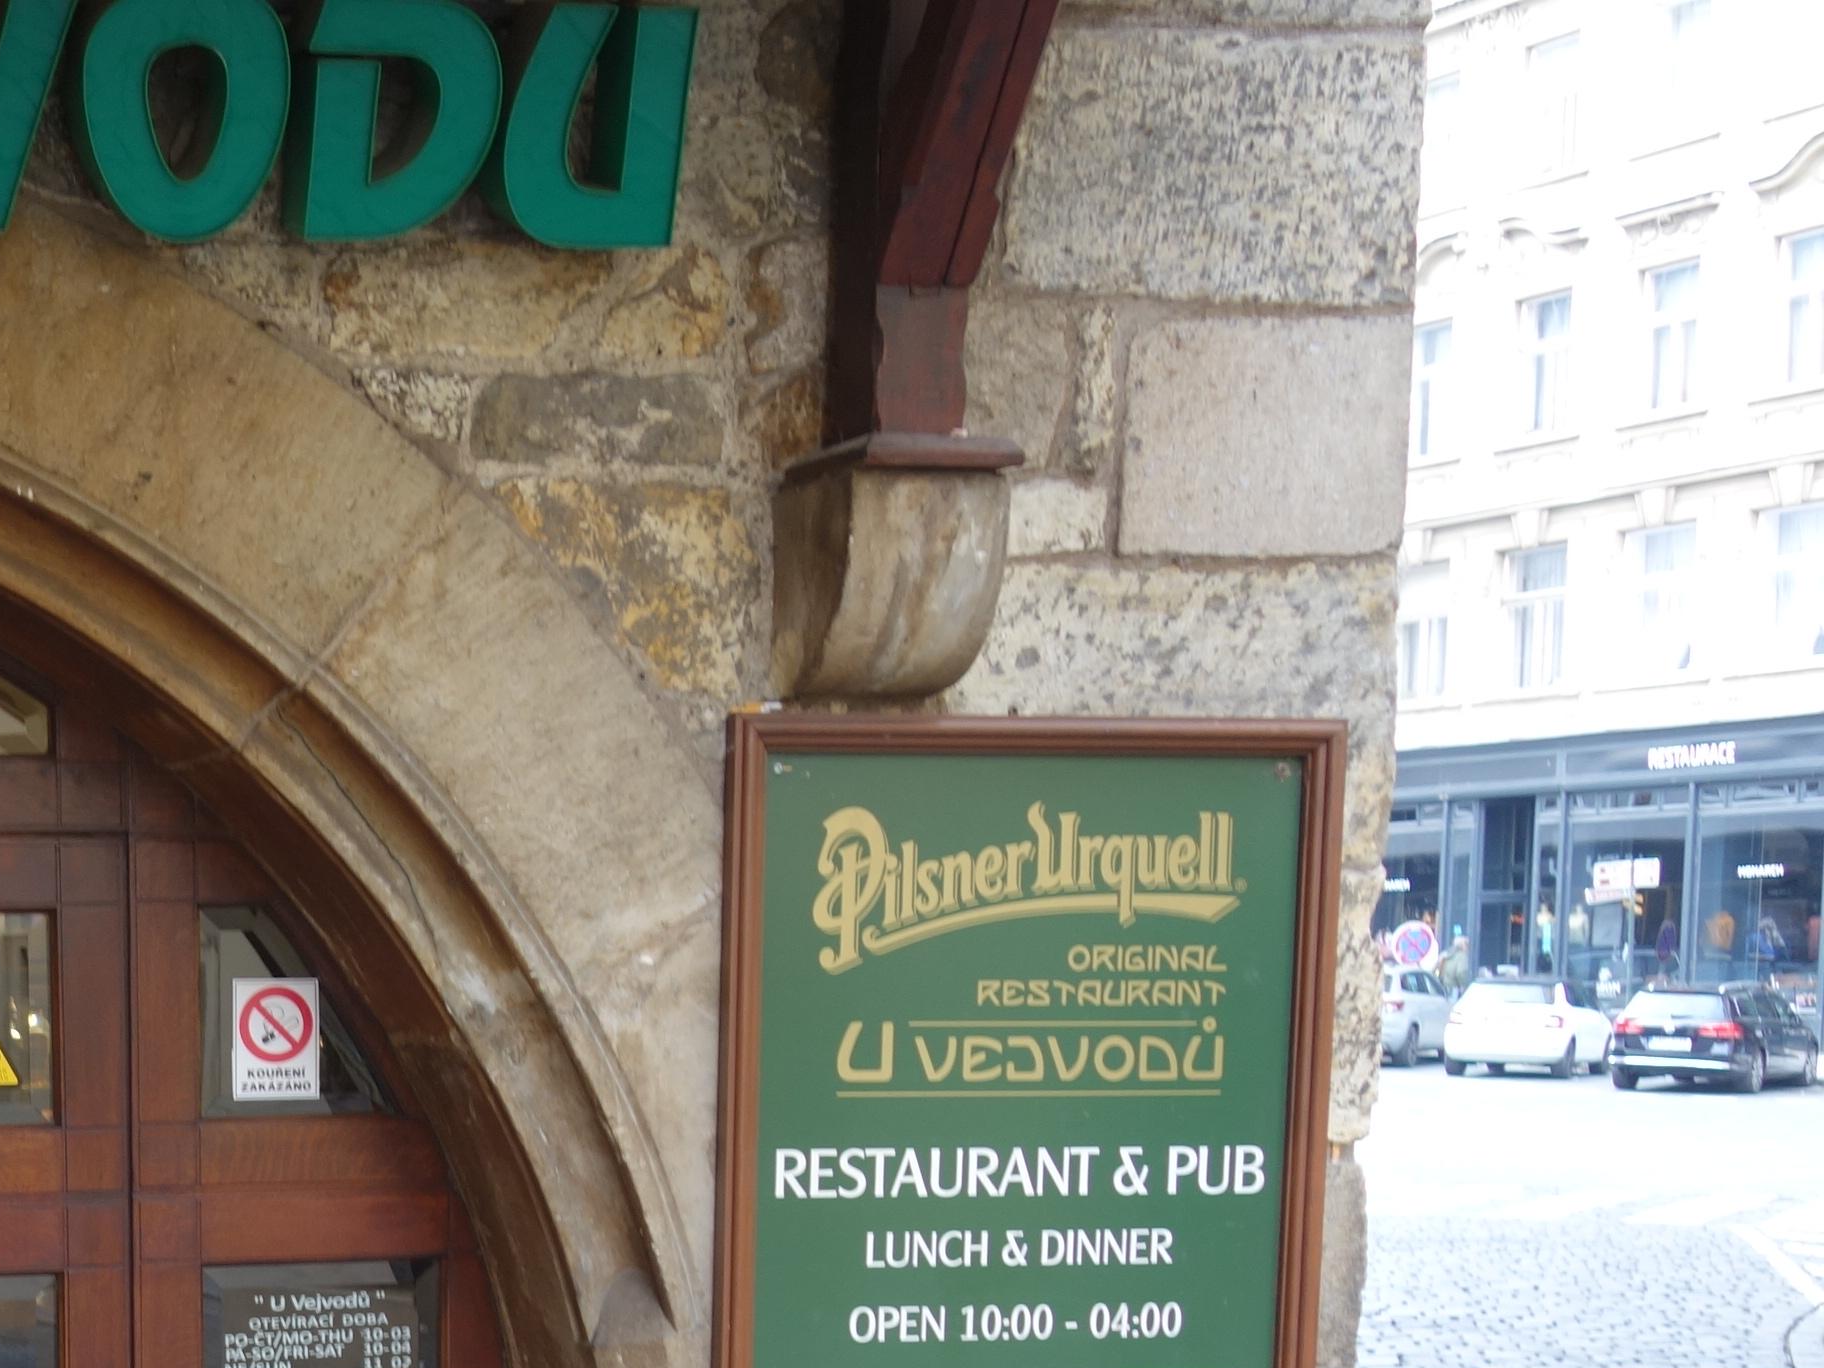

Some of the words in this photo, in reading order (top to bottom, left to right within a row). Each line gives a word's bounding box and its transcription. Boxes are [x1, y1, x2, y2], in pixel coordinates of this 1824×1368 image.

[1647, 741, 1736, 771] RESTAURACE
[812, 804, 1036, 975] Pilsner
[1027, 801, 1234, 928] Urquell
[1067, 945, 1227, 972] ORIGINAL
[977, 979, 1227, 1007] RESTAURANT
[836, 1021, 894, 1083] U
[775, 1146, 1100, 1199] RESTAURANT
[1113, 1146, 1148, 1196] &
[1167, 1144, 1265, 1196] PUB
[866, 1231, 988, 1269] LUNCH
[1001, 1230, 1028, 1267] &
[1041, 1228, 1173, 1266] DINNER
[248, 1311, 335, 1331] OTEVÍRACÍ
[342, 1312, 389, 1326] DOBA
[849, 1306, 945, 1343] OPEN
[960, 1304, 1053, 1341] 10:00
[1089, 1302, 1182, 1339] 04:00
